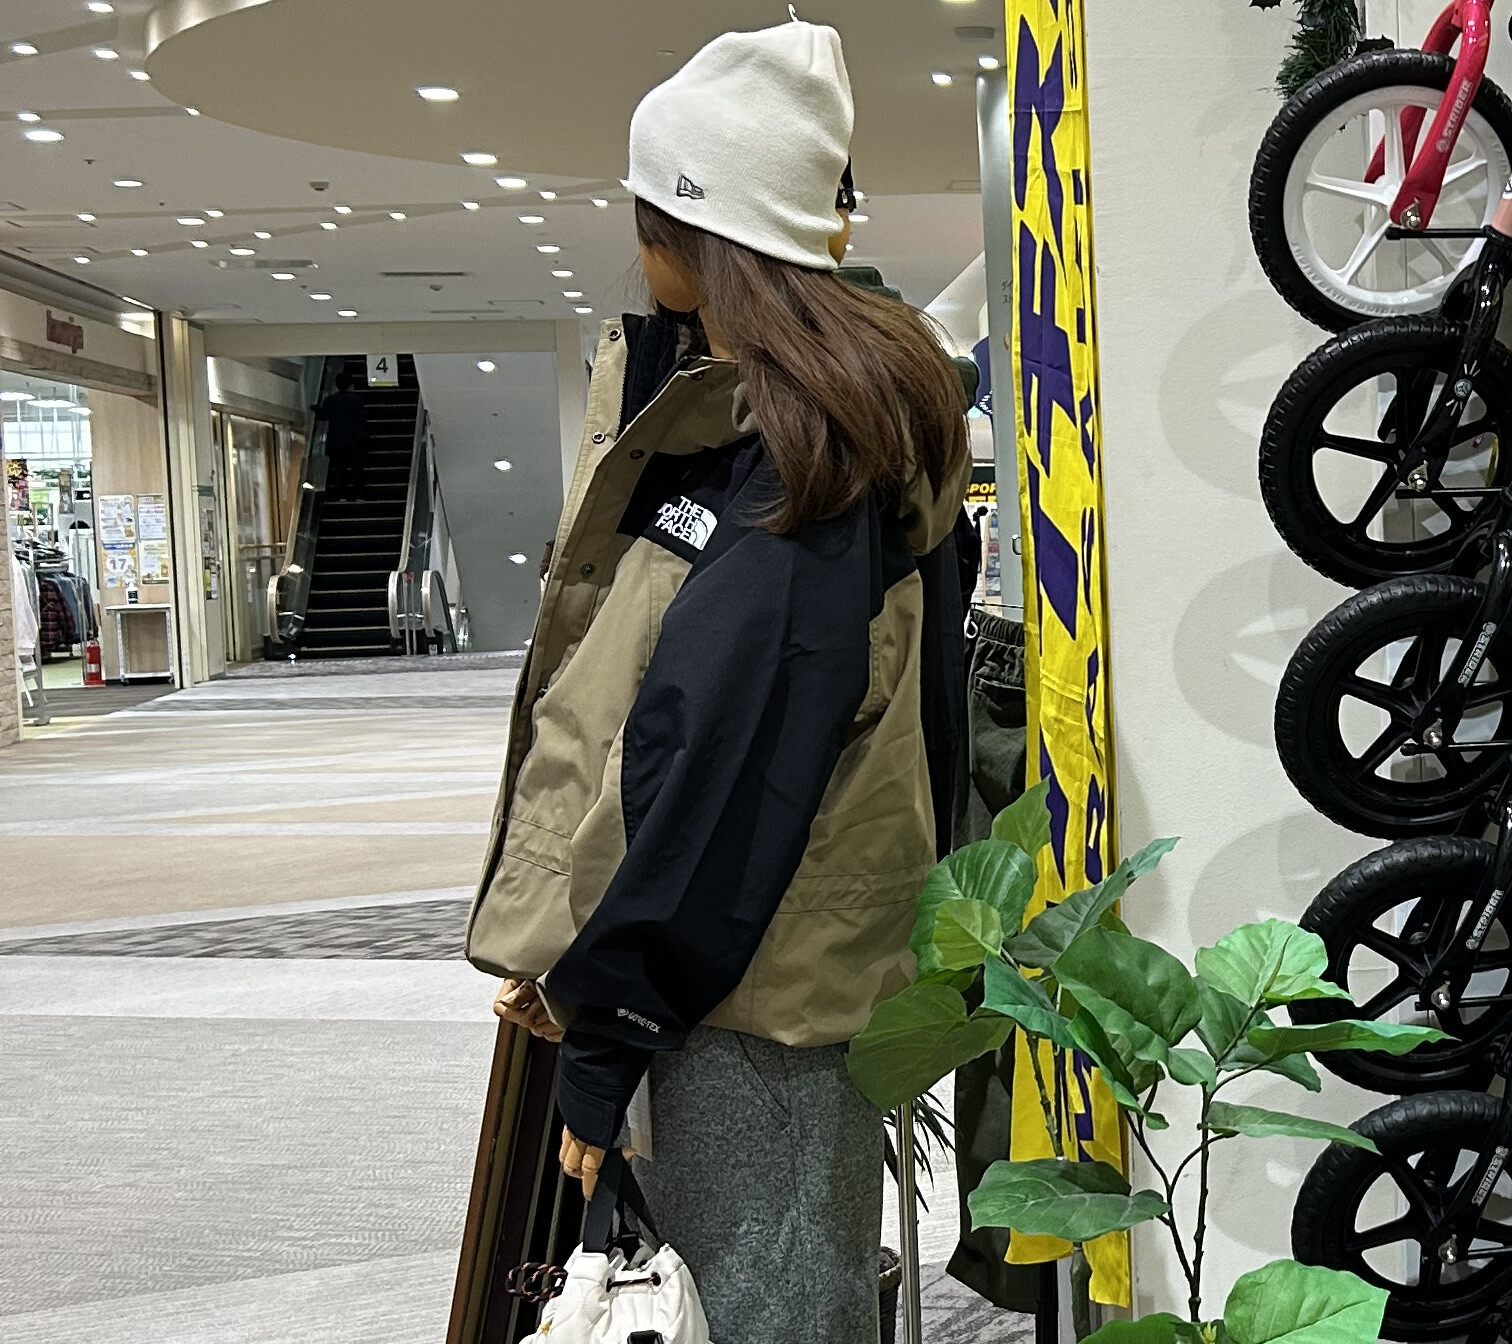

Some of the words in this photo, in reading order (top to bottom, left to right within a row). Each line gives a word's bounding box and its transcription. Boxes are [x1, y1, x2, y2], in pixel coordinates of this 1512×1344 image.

[375, 356, 389, 374] 4
[679, 495, 704, 519] THE
[654, 515, 692, 541] FACE
